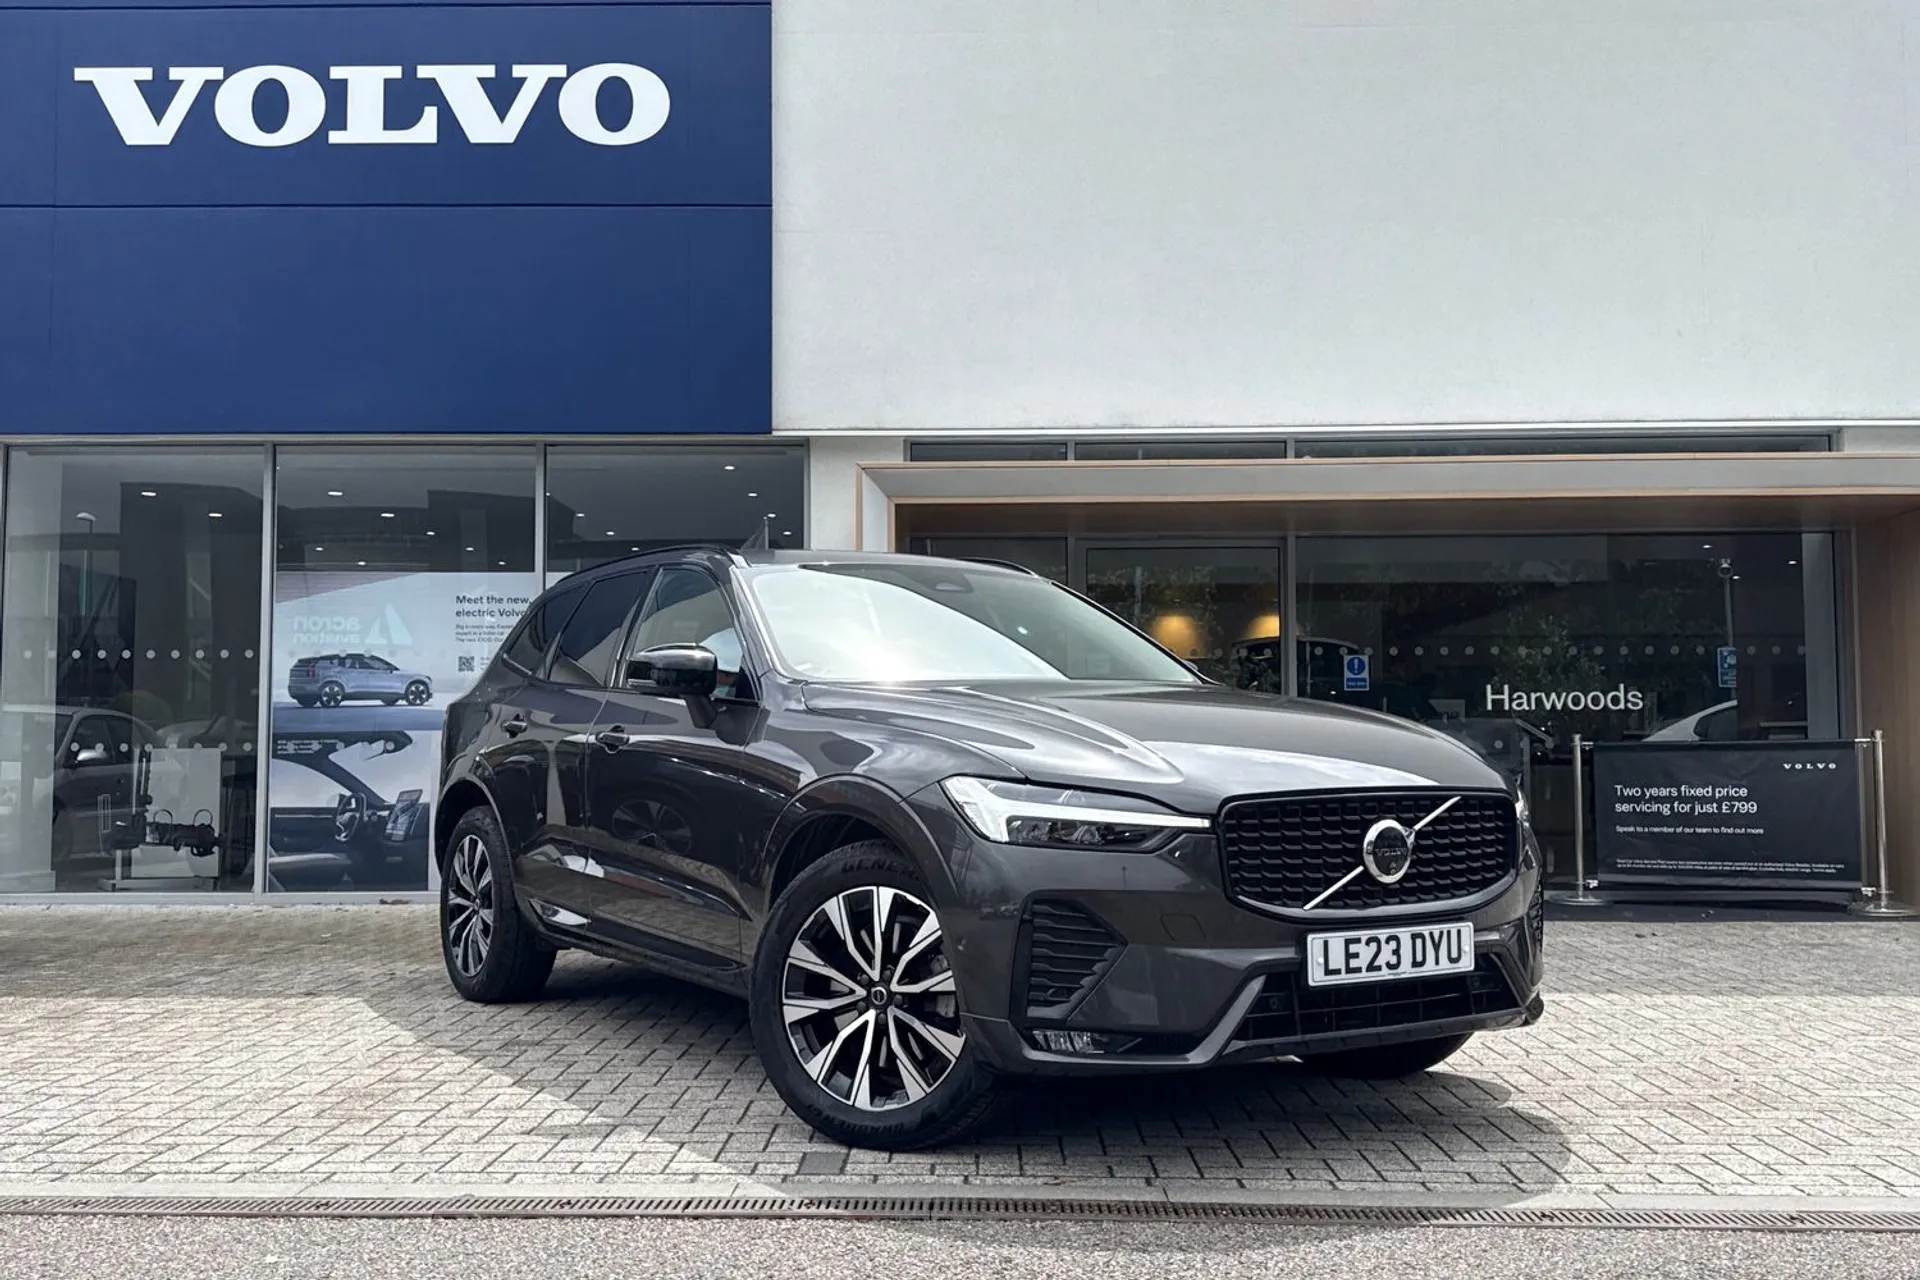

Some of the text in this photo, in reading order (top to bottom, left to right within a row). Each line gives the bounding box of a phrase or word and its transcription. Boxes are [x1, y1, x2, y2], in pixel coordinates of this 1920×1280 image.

[74, 63, 671, 147] VOLVO
[455, 595, 484, 605] Meet
[486, 595, 504, 605] the
[455, 608, 496, 618] electric
[1485, 683, 1644, 711] Harwoods
[1614, 785, 1748, 799] Two years fixed price
[1615, 801, 1757, 815] servicing for just £799
[1616, 825, 1635, 834] Speak
[1649, 825, 1674, 833] member
[1721, 826, 1733, 834] find
[841, 859, 921, 881] GENER
[1323, 929, 1462, 976] LE23 DYU
